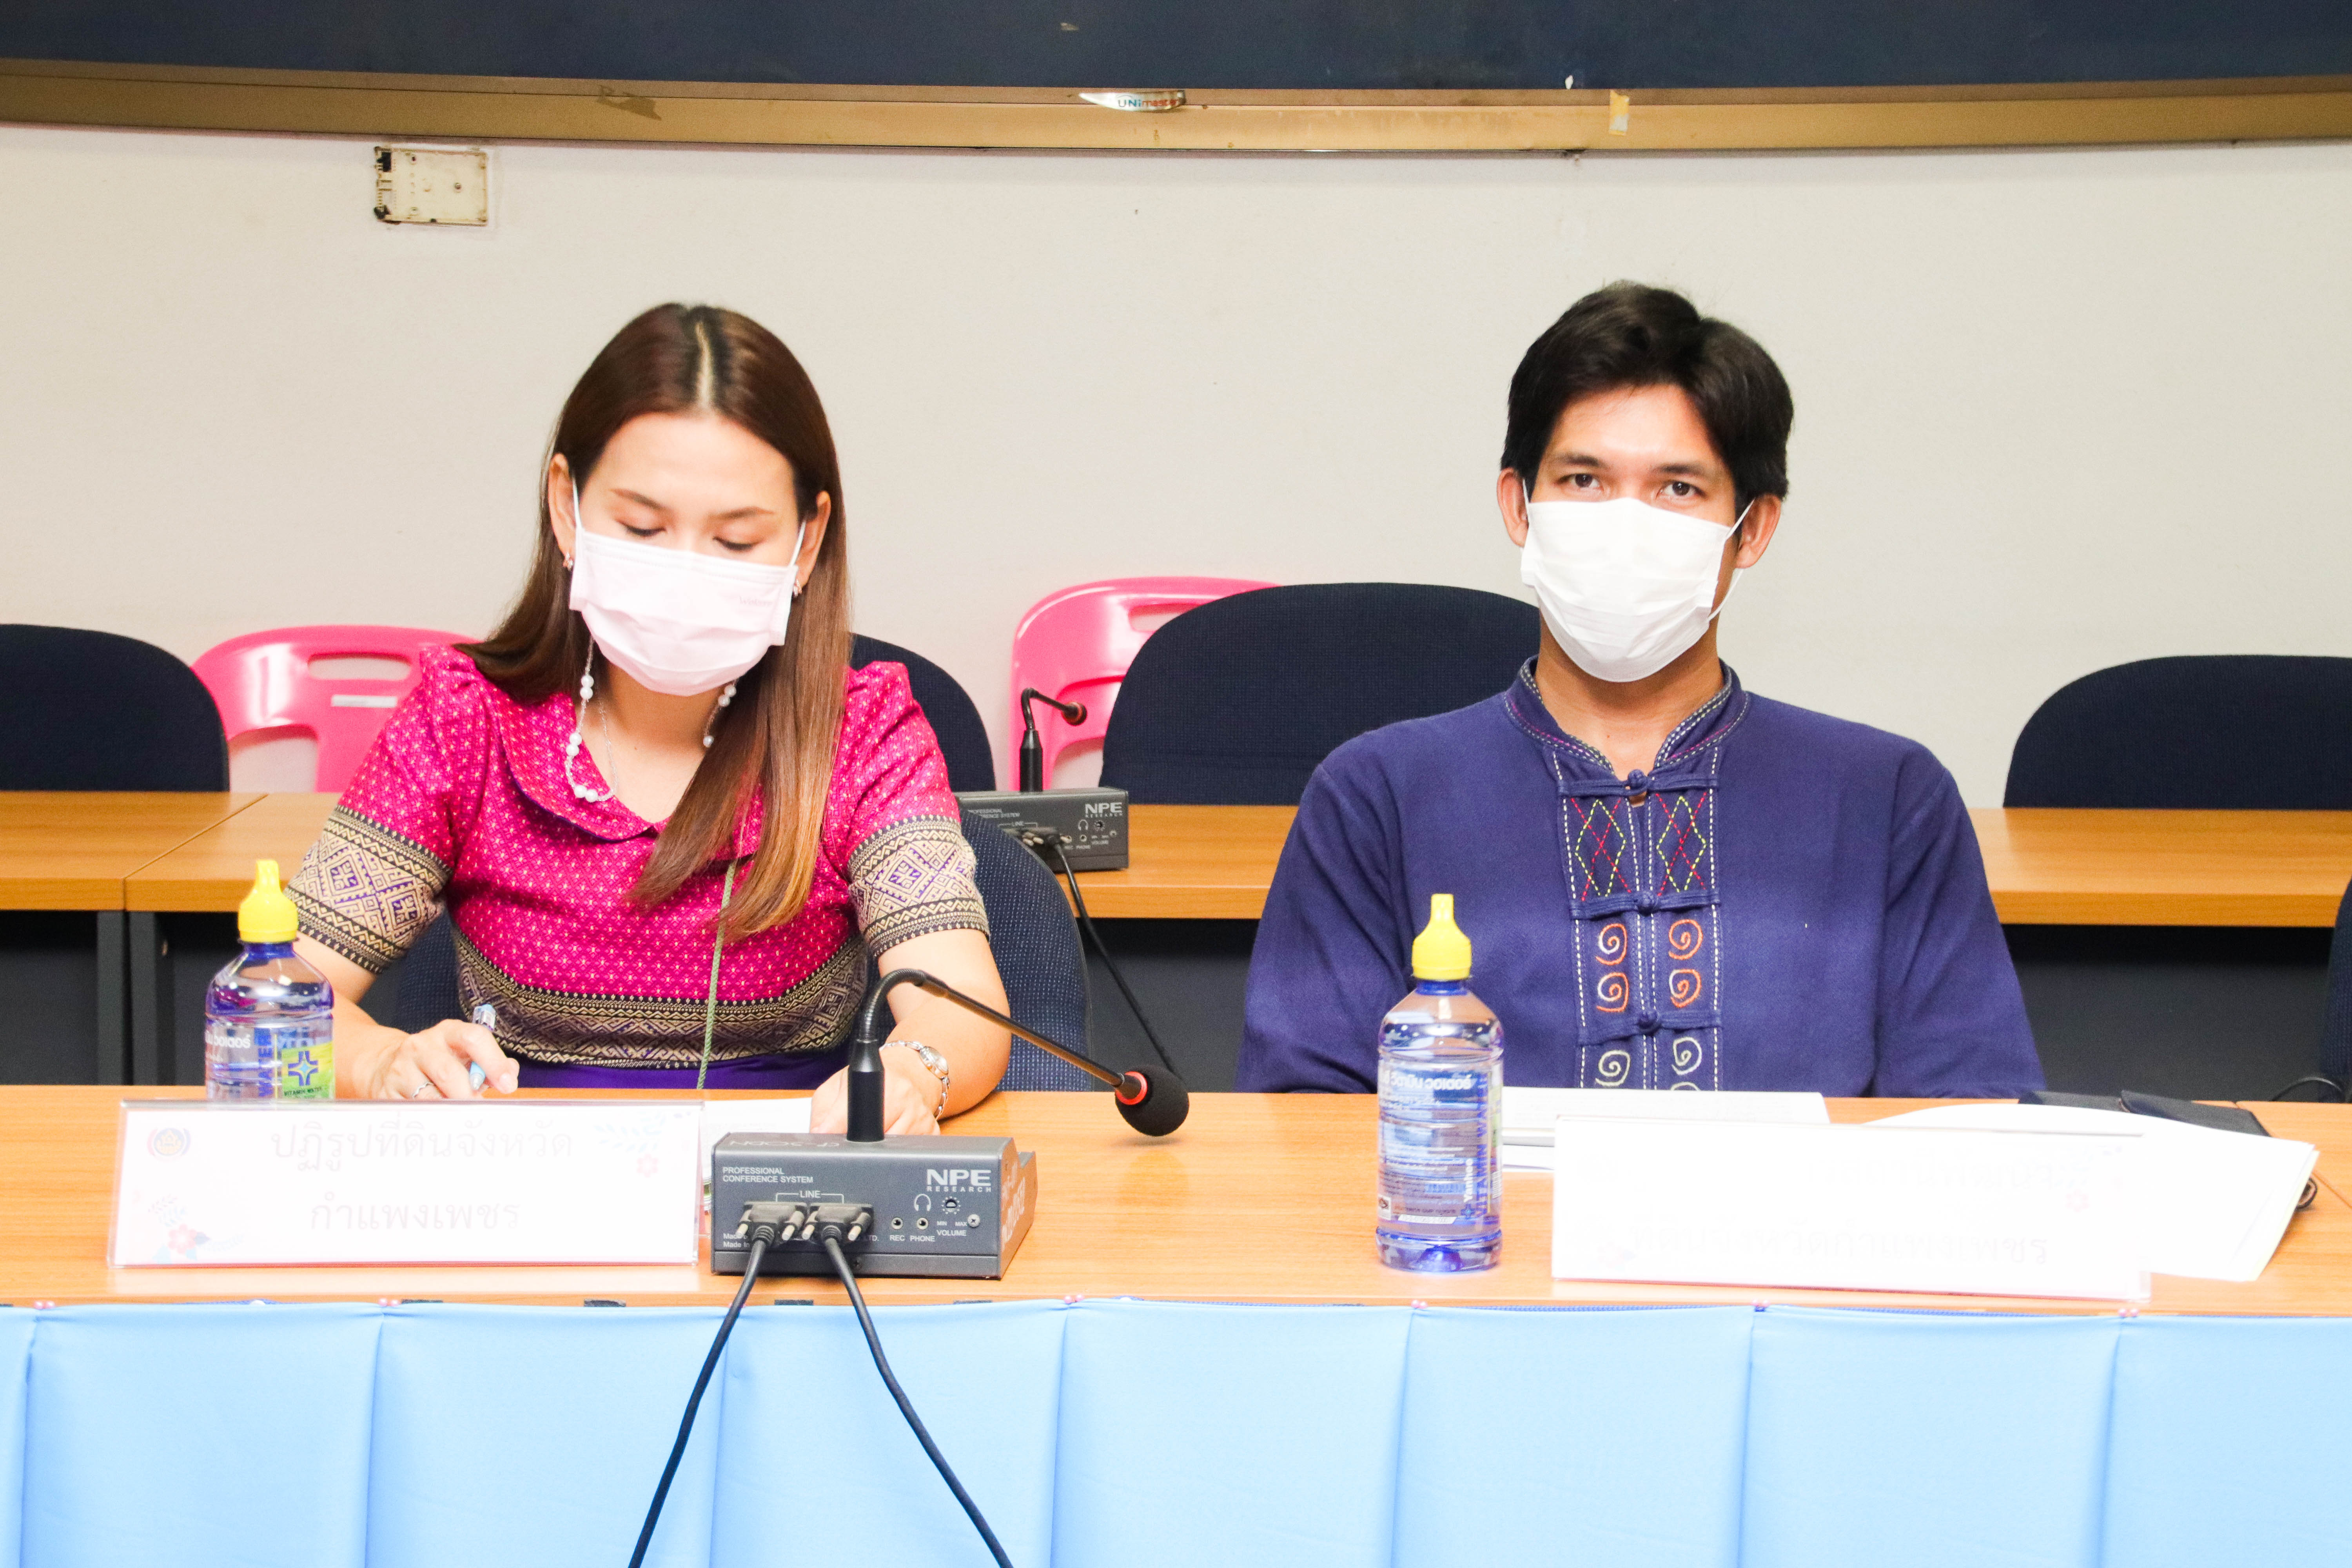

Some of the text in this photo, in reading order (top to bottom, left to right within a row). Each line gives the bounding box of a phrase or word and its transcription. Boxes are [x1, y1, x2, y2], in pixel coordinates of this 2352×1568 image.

[1085, 802, 1122, 814] NPE
[722, 1167, 785, 1175] PROFESSIONAL
[927, 1169, 991, 1186] NPE
[800, 1190, 821, 1198] LINE
[310, 1190, 521, 1231] กำแพงเพชร
